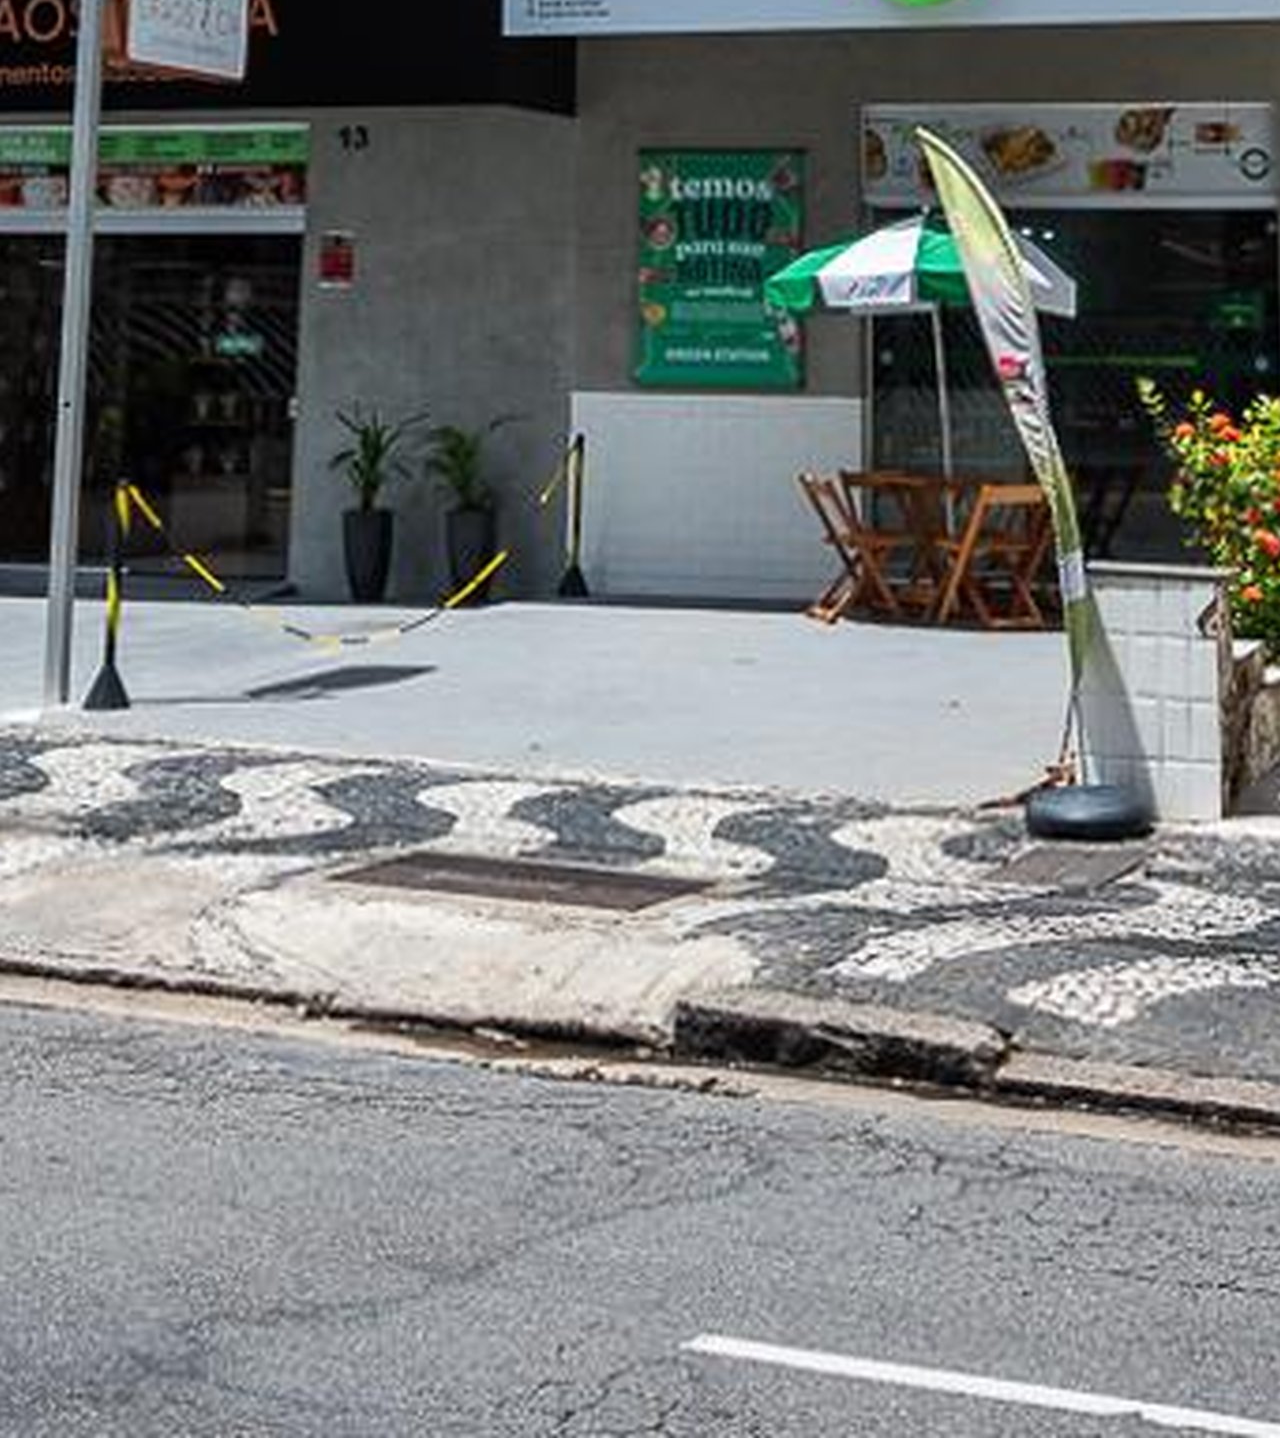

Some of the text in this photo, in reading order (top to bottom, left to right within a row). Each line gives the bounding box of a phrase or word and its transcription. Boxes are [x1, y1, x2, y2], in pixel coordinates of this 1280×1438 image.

[338, 124, 370, 152] 13
[669, 175, 774, 201] temos
[675, 241, 723, 261] para
